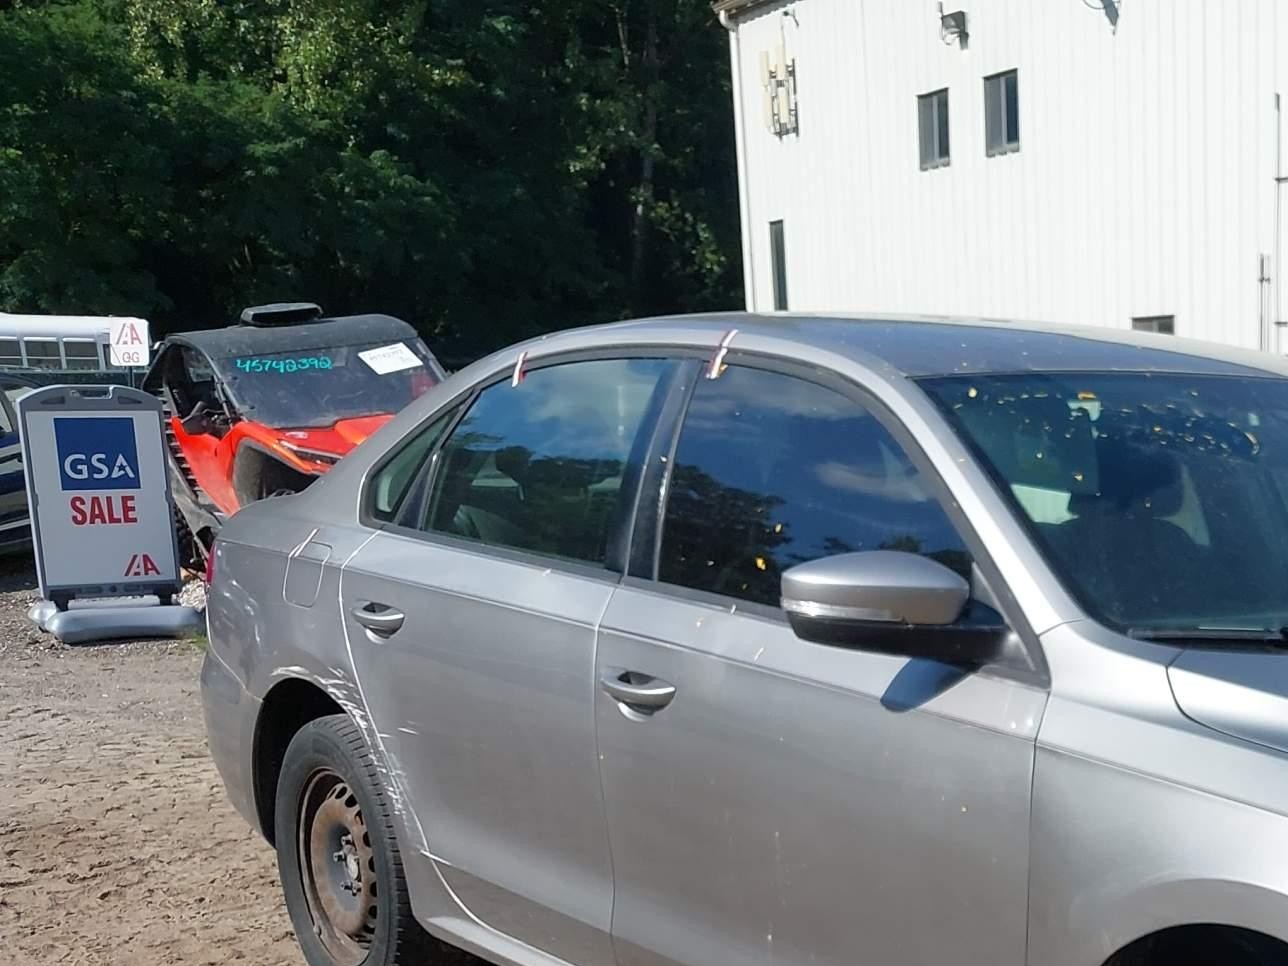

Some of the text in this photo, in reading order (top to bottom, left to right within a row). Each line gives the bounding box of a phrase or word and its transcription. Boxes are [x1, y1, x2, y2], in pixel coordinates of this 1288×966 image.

[236, 357, 333, 373] 45742392
[64, 453, 135, 479] GSA
[70, 495, 138, 525] SALE
